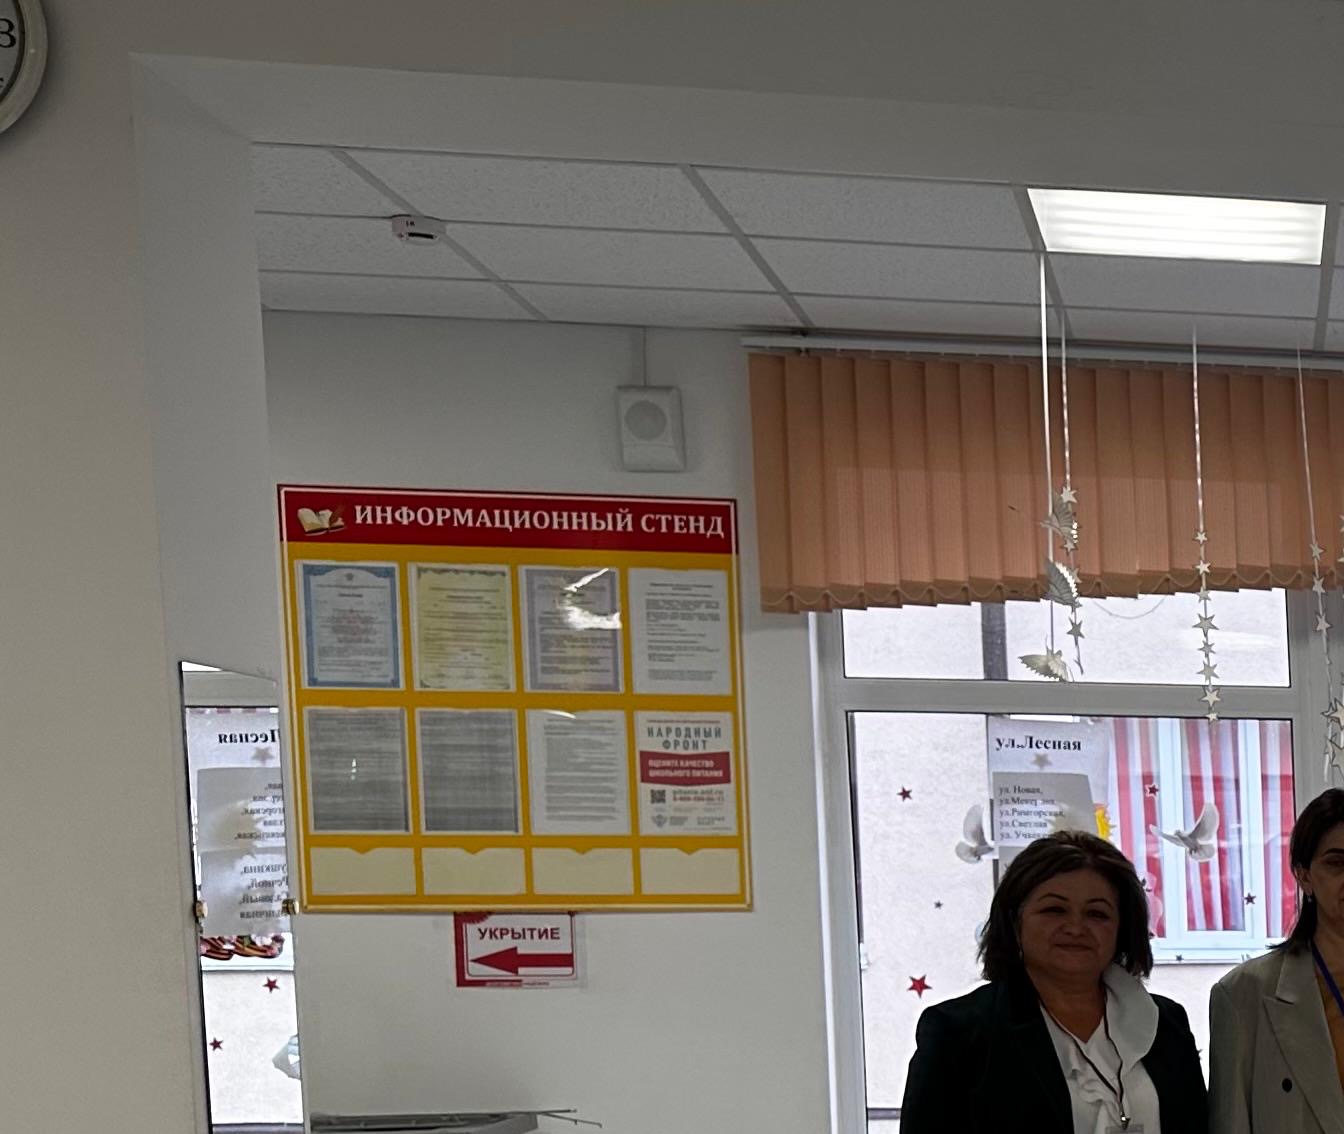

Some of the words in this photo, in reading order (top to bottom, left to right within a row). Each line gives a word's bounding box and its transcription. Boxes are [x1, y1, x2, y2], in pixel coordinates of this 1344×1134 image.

[354, 504, 635, 533] ИНФОРМАЦИОННЫЙ
[640, 513, 725, 537] СТЕНД
[647, 727, 722, 739] НАРОДНЫЙ
[662, 740, 707, 750] ФРОНТ
[478, 926, 561, 941] УКРЫТИЕ
